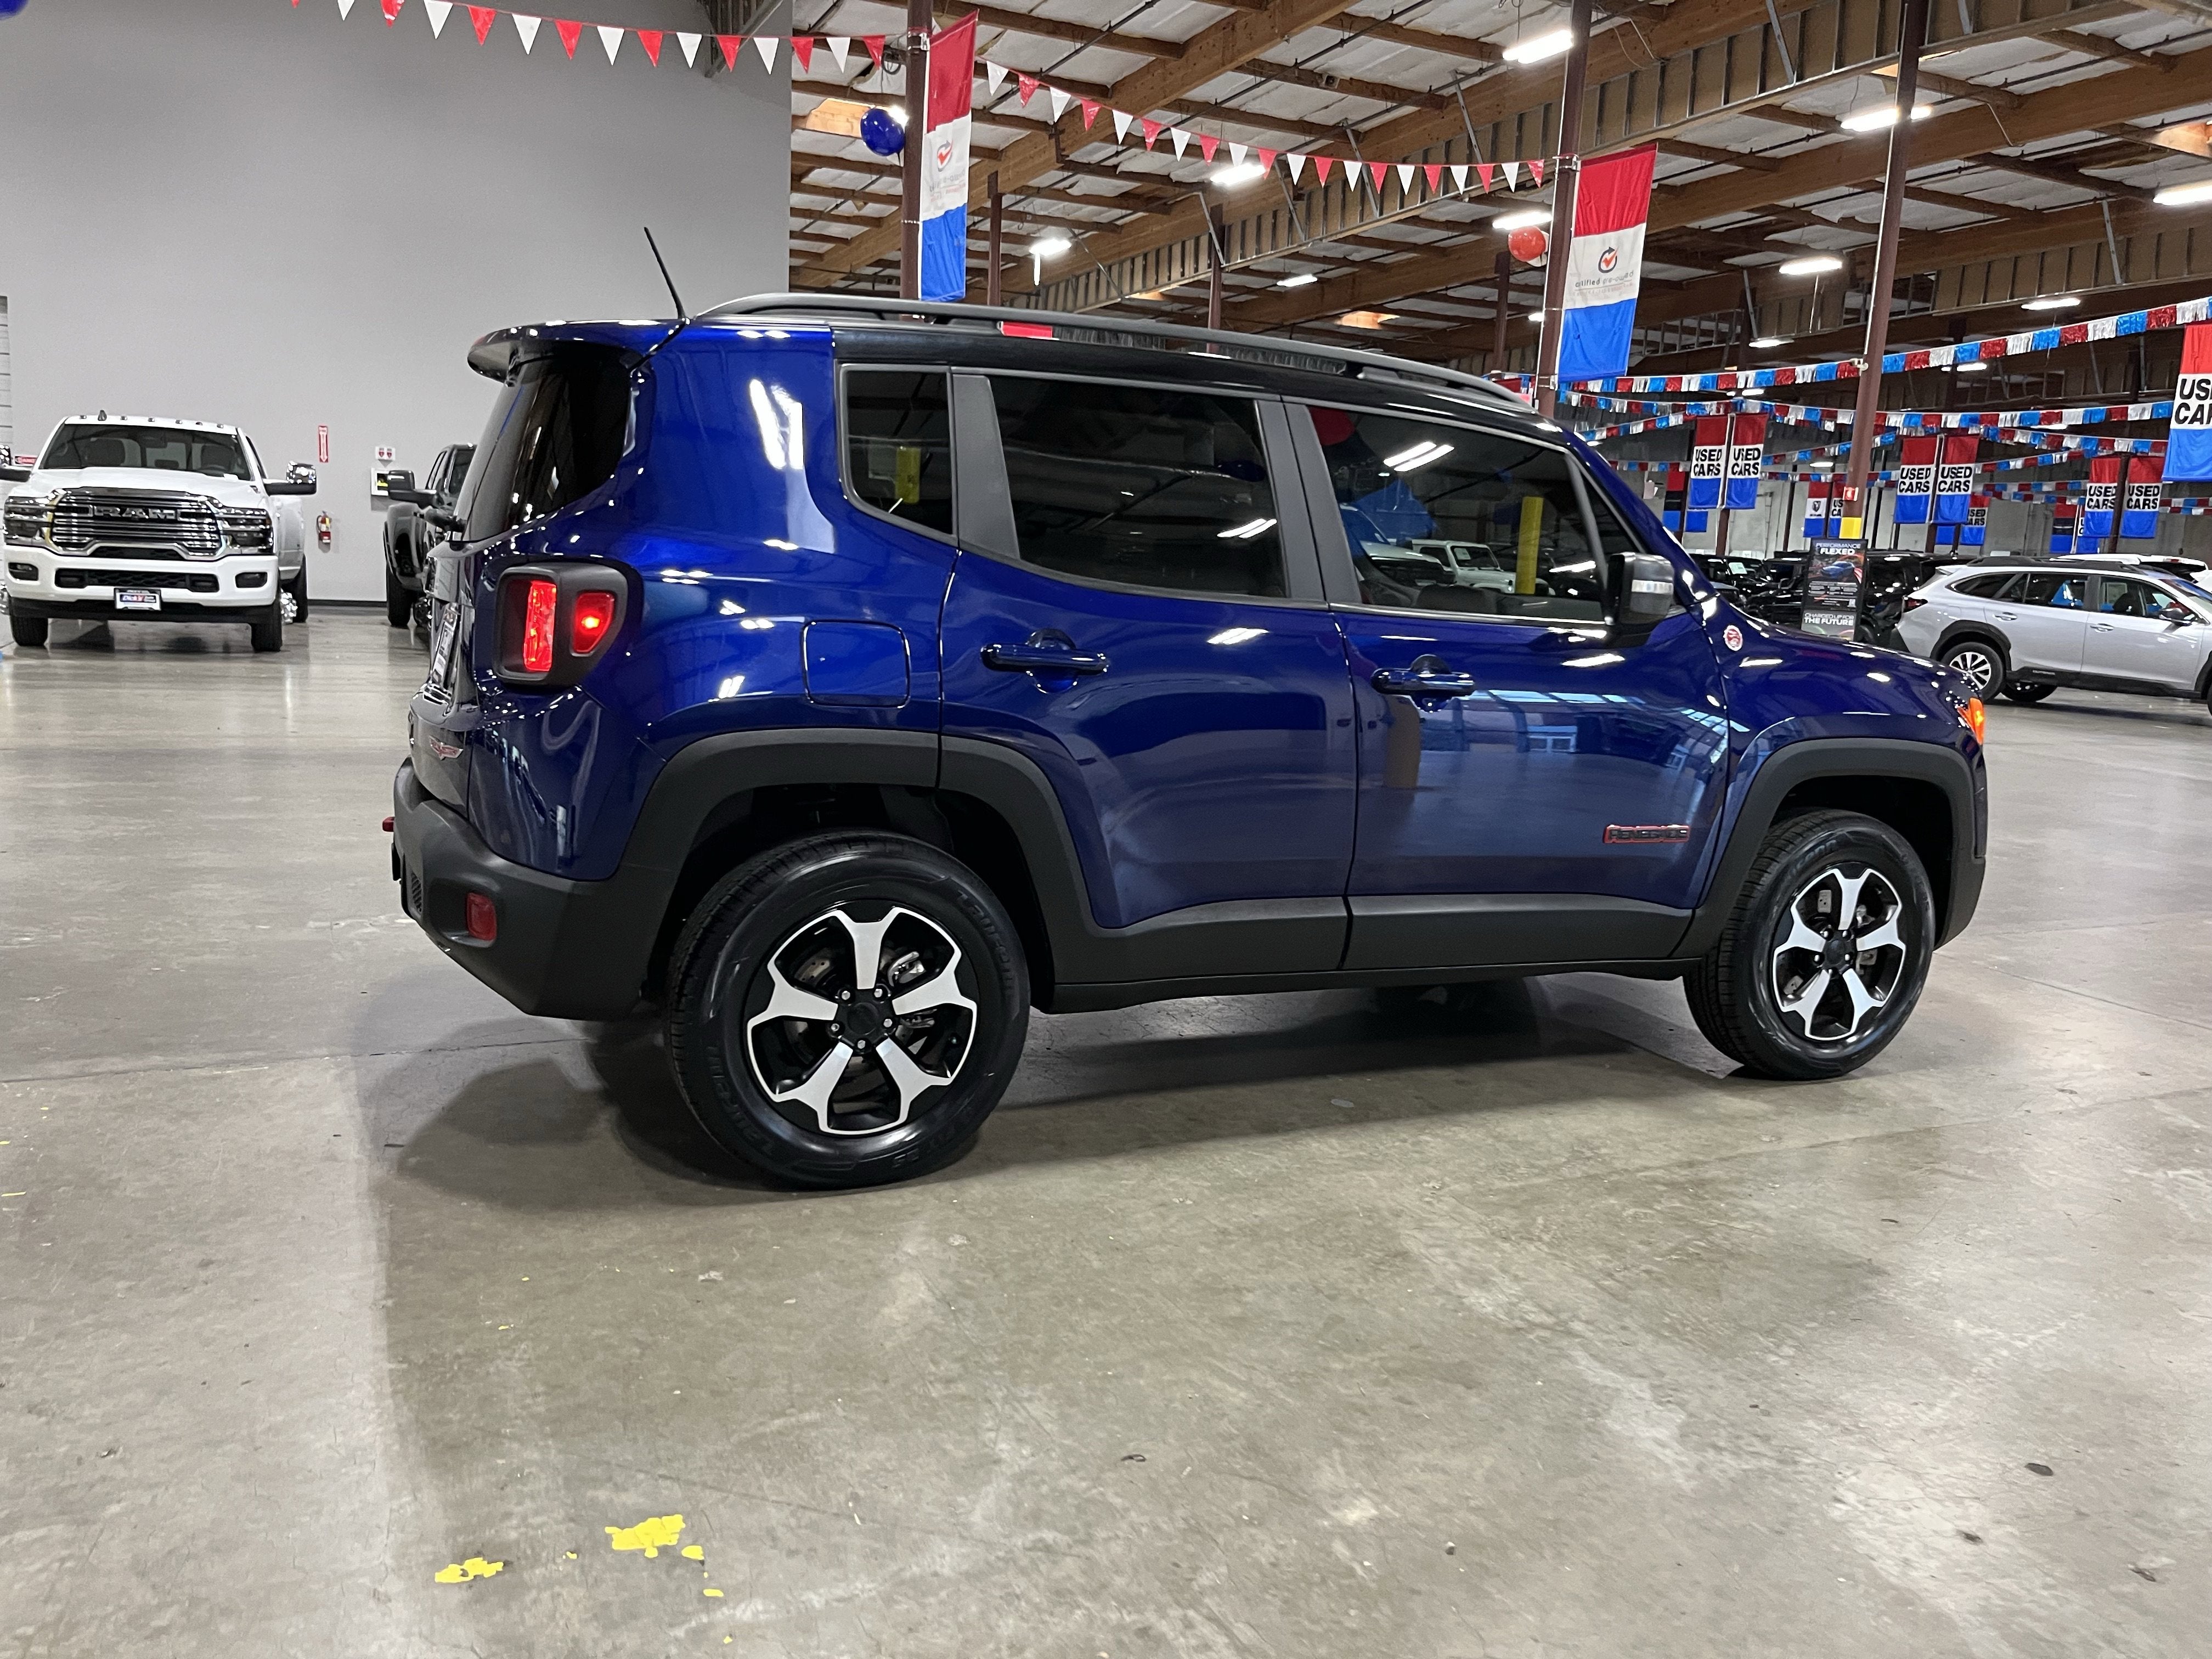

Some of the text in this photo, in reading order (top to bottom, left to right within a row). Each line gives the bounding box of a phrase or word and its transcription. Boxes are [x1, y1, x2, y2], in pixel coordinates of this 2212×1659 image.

[2180, 379, 2212, 400] US
[2175, 403, 2212, 425] CA
[1695, 449, 1722, 462] USED
[1693, 463, 1721, 476] CARS
[1900, 467, 1931, 480] USED
[1940, 466, 1972, 479] USED
[1899, 481, 1930, 493] CARS
[1938, 480, 1970, 493] CARS
[2128, 486, 2160, 497] USED
[2087, 498, 2115, 510] CARS
[2126, 498, 2158, 510] CARS
[94, 504, 176, 520] RAM
[1968, 518, 1985, 526] ARS
